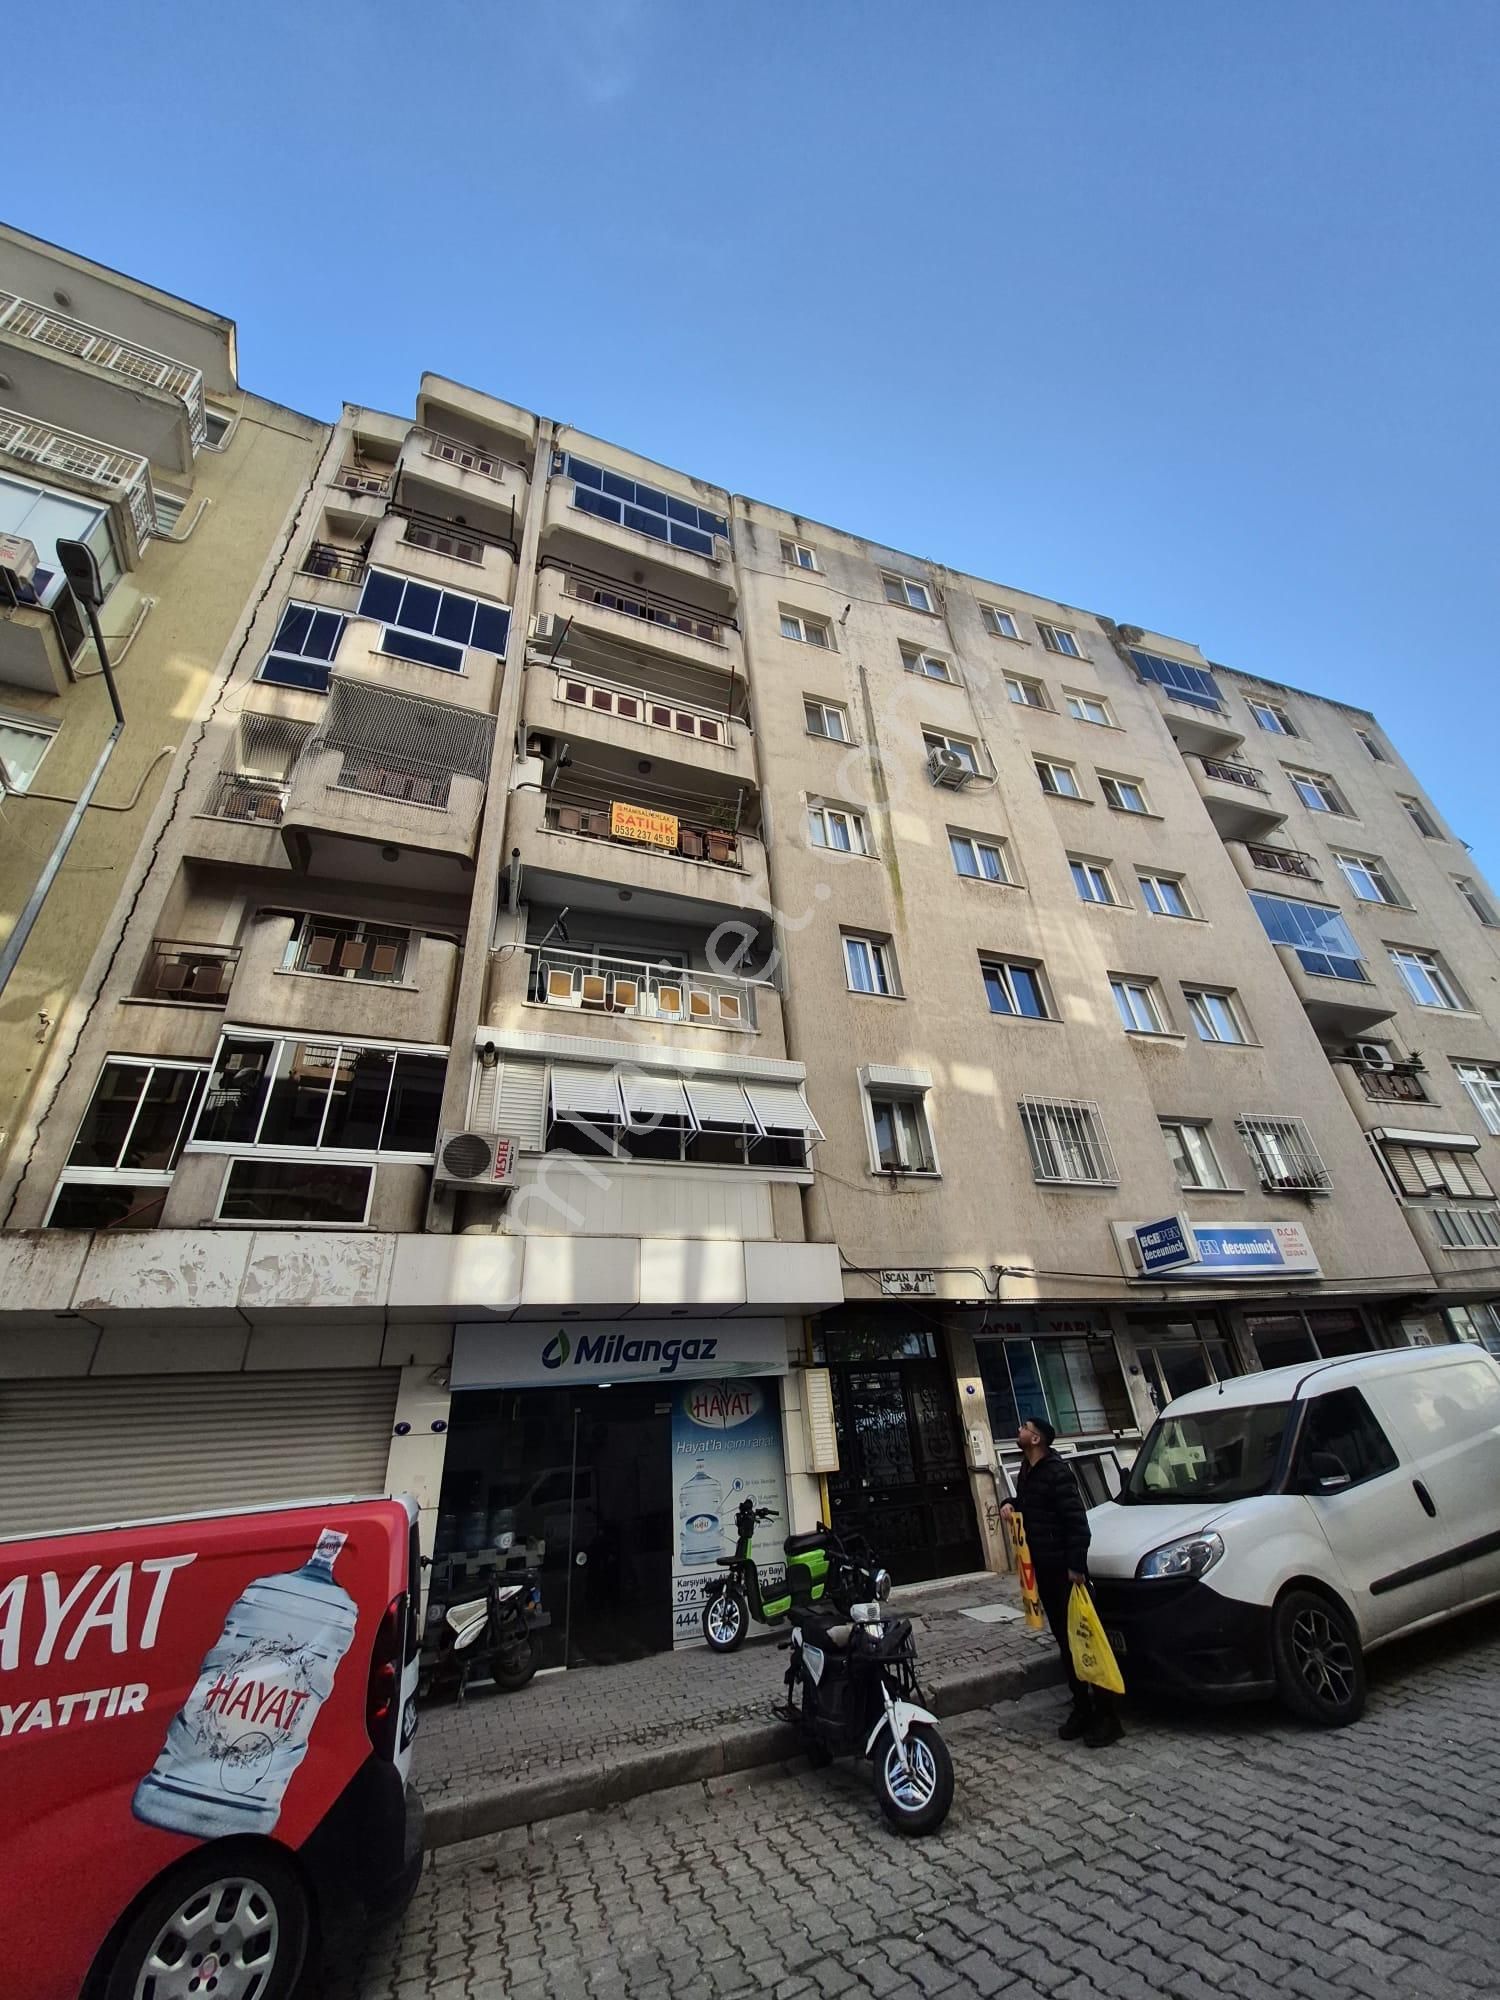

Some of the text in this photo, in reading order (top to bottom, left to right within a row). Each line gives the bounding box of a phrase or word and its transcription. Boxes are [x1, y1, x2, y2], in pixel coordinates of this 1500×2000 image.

[616, 812, 674, 835] SATILIK
[615, 825, 675, 846] 0532 237 45 95
[494, 1139, 510, 1179] VESTEL
[1144, 1240, 1185, 1262] deceuninck
[1222, 1239, 1278, 1255] deceuninck
[574, 1335, 718, 1373] Milangaz
[693, 1392, 752, 1418] HAYAT
[676, 1439, 722, 1454] Hayat'la
[677, 1589, 697, 1602] 372
[676, 1611, 699, 1628] 444
[203, 1672, 310, 1731] HAYAT
